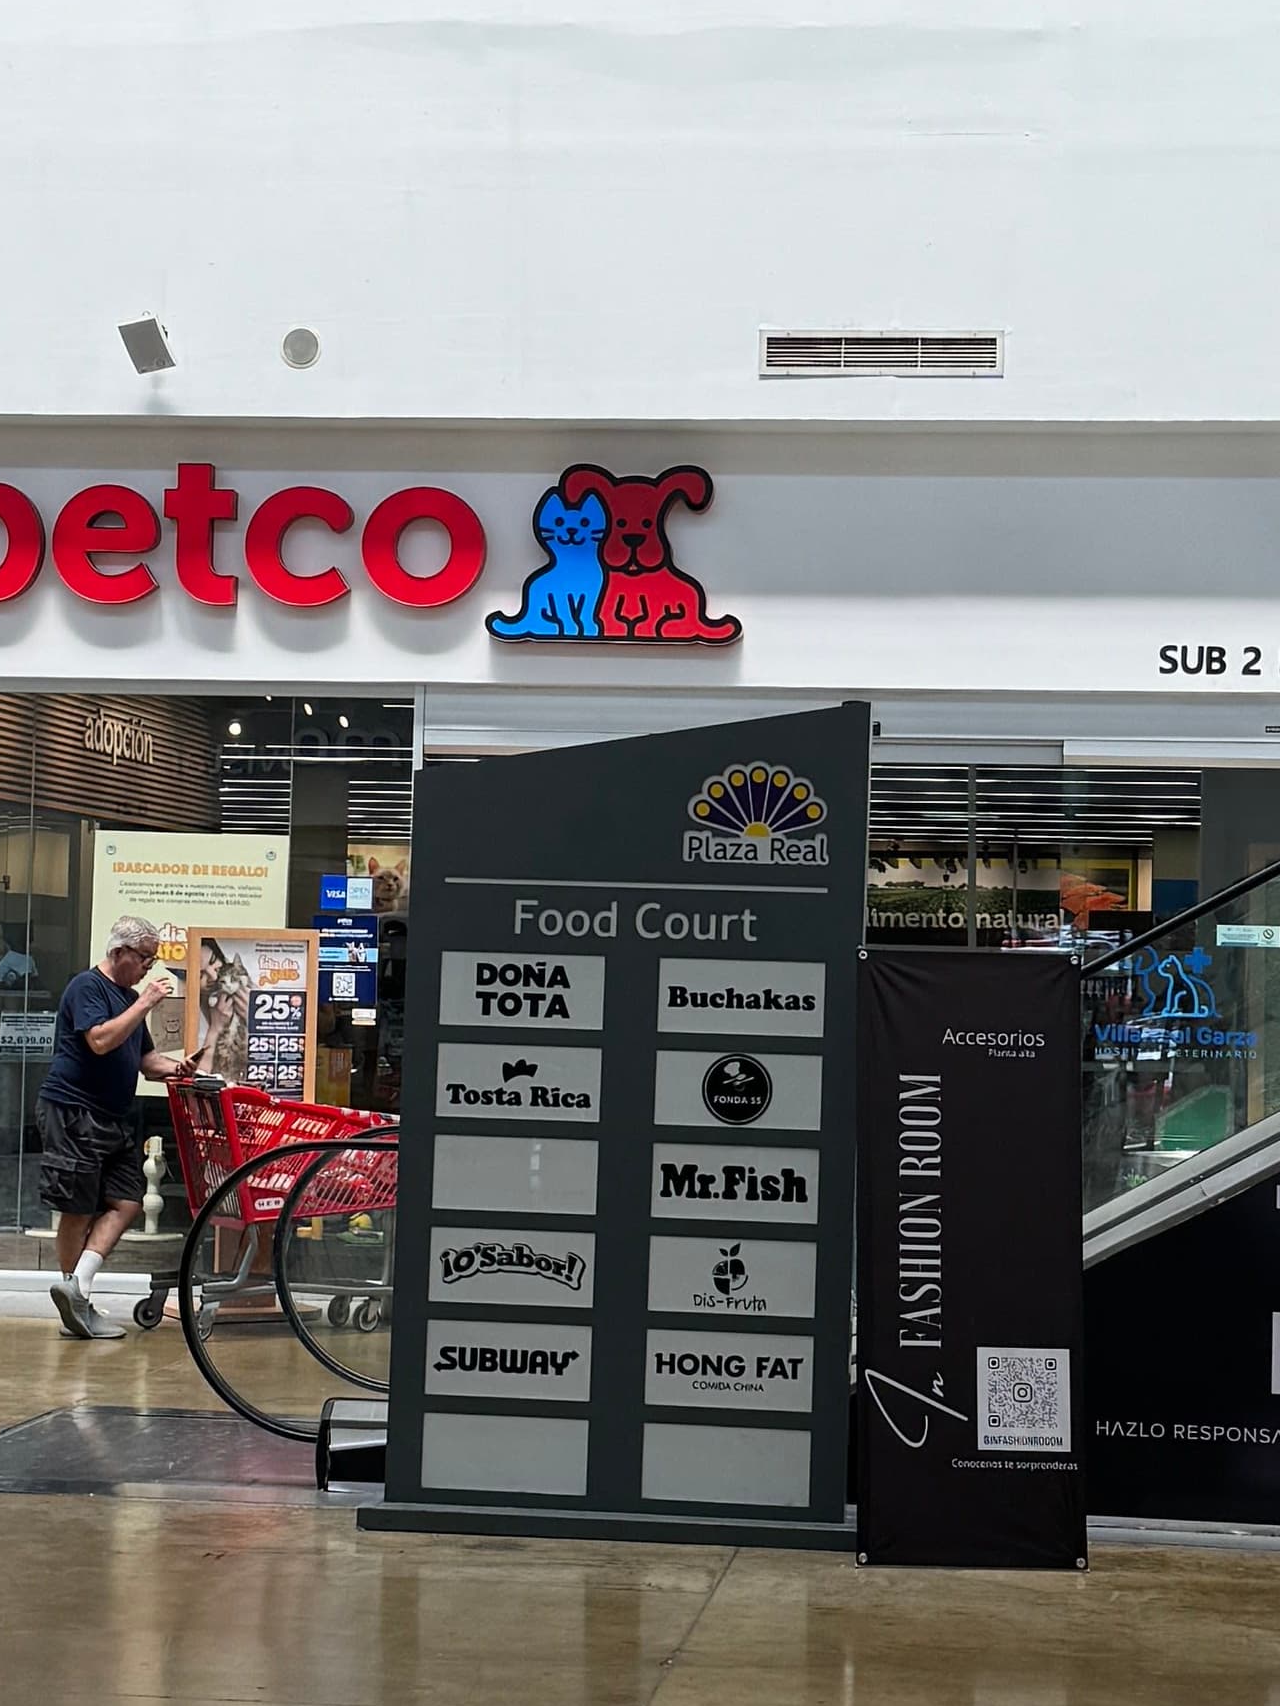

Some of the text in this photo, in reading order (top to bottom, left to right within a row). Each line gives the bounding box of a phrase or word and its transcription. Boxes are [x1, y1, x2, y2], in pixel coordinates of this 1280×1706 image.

[1158, 645, 1227, 677] SUB
[1240, 645, 1263, 677] 2
[83, 707, 155, 766] adopción
[687, 835, 827, 863] Plaza Real
[325, 889, 347, 899] VISA
[513, 898, 759, 943] Food Court
[864, 906, 1065, 930] limento natural
[475, 960, 571, 990] DOÑA
[475, 990, 571, 1019] TOTA
[667, 985, 816, 1012] Buchakas
[942, 1028, 1046, 1048] Accesorios
[1195, 1026, 1258, 1047] Garza
[1166, 1048, 1258, 1060] ETERINARIO
[445, 1083, 523, 1107] Tosta
[713, 1095, 748, 1105] FONDA
[659, 1162, 809, 1204] Mr.Fish
[898, 1073, 943, 1350] FASHION ROOM
[432, 1345, 580, 1376] SUBWAY
[654, 1352, 805, 1381] HONG FAT
[692, 1380, 765, 1392] COMIDA CHINA
[1095, 1420, 1166, 1439] HAZLO
